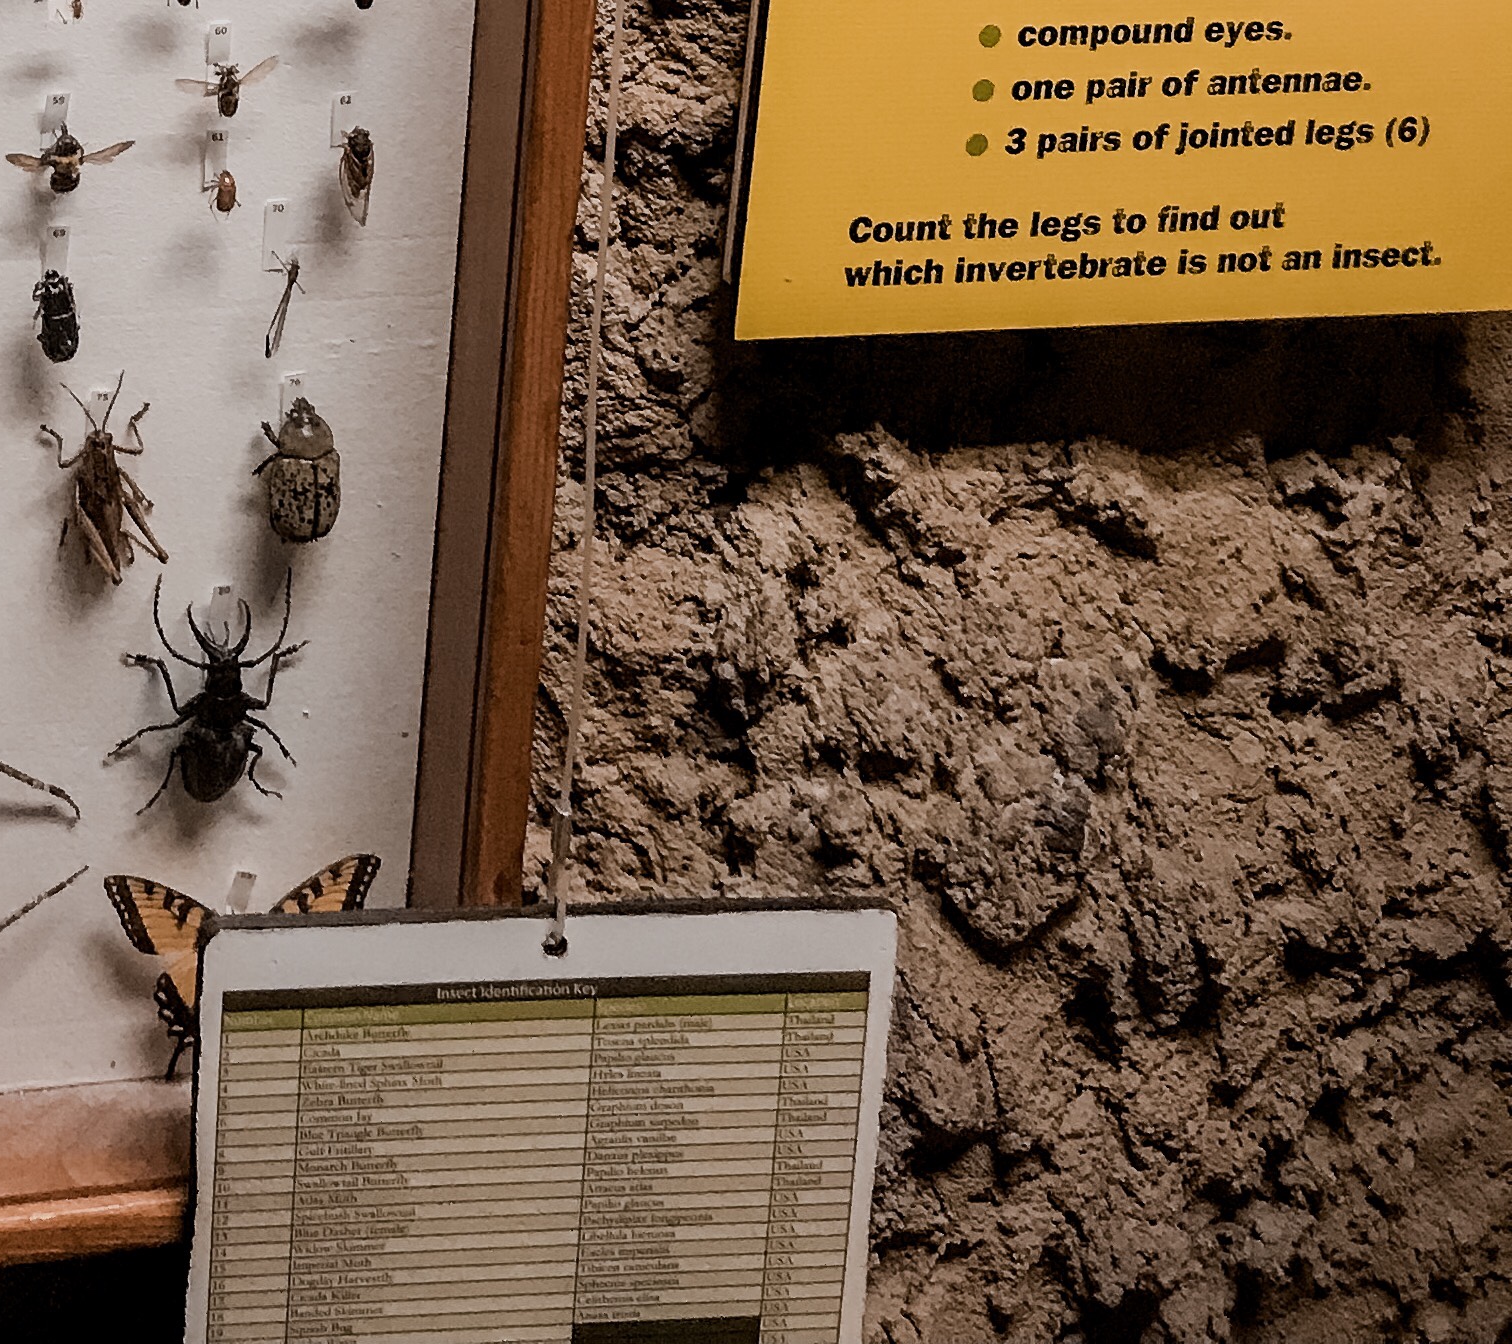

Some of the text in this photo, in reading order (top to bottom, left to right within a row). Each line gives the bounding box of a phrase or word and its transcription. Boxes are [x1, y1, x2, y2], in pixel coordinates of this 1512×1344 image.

[214, 26, 228, 36] 60
[1018, 17, 1292, 51] compound eyes.
[1012, 68, 1371, 105] one pair of antennae.
[1005, 116, 1430, 159] 3 pairs of jointed legs (6)
[272, 203, 285, 213] 70
[849, 202, 1285, 243] Count the legs to find out
[845, 241, 1441, 287] which invertebrate is not an insect.
[437, 983, 597, 999] Insect Identification Key
